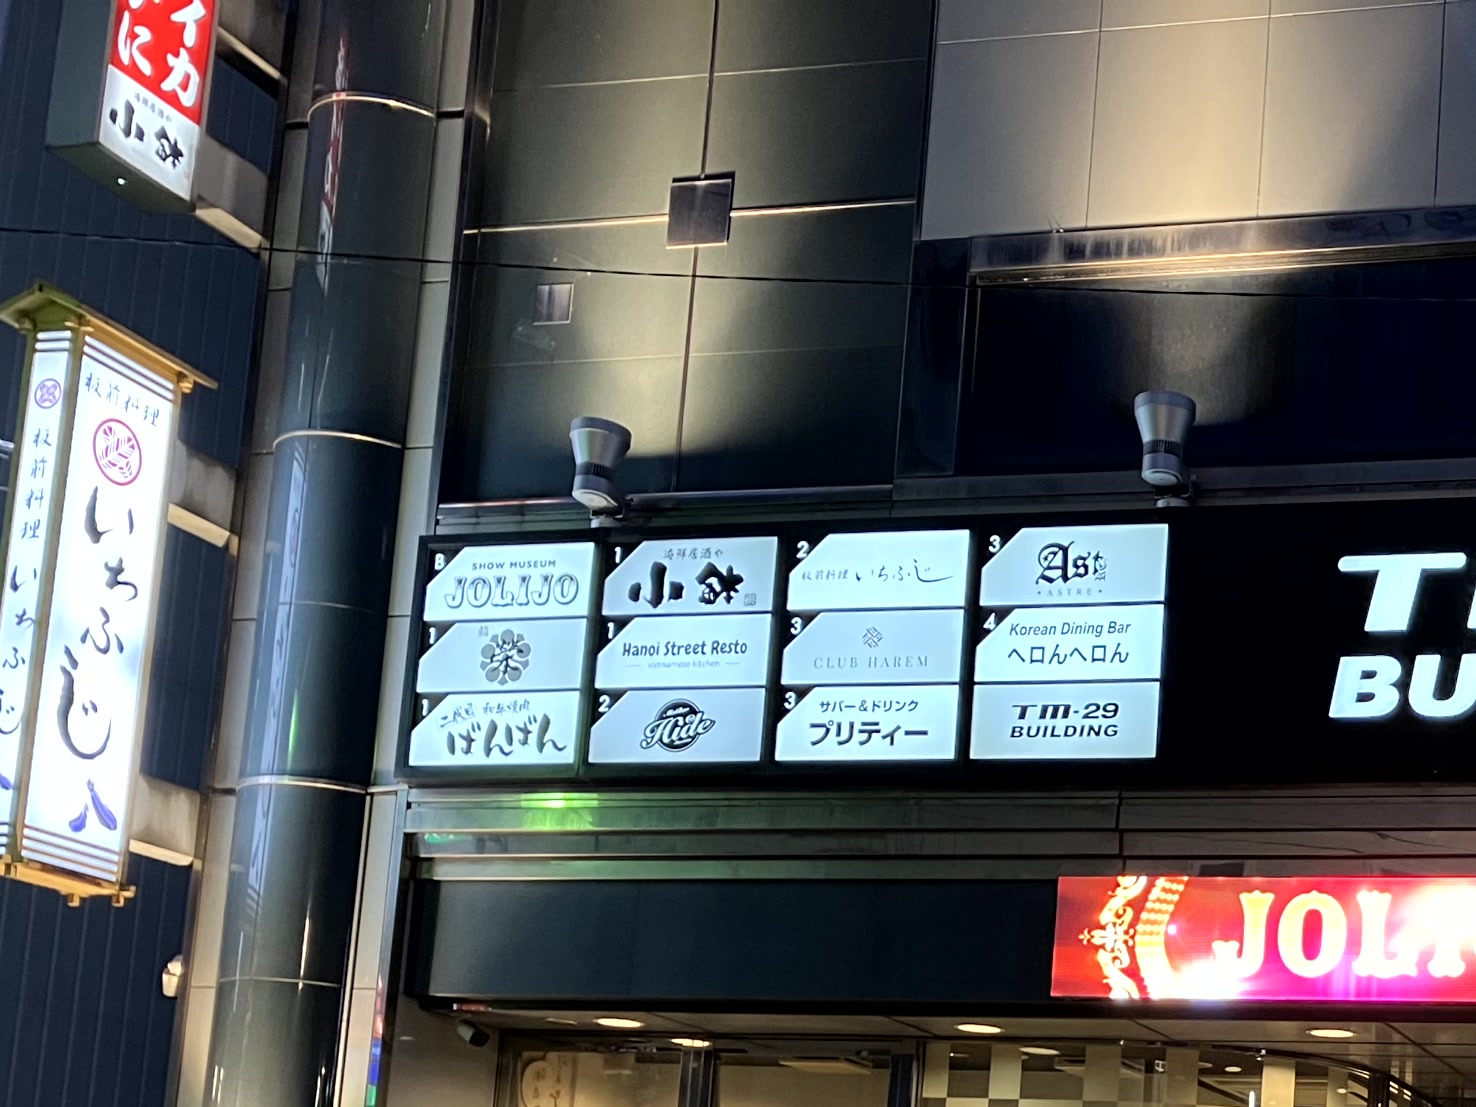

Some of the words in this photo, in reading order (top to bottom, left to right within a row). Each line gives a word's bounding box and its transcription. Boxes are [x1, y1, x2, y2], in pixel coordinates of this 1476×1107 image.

[85, 372, 160, 428] 板前料理
[796, 541, 809, 558] 2
[988, 535, 1001, 553] 3
[434, 553, 445, 570] B
[614, 547, 622, 563] 1
[471, 561, 505, 571] SHOW
[509, 559, 557, 570] MUSEUM
[444, 573, 579, 609] JOLIJO
[607, 623, 615, 639] 1
[790, 617, 802, 635] 3
[983, 613, 997, 631] 4
[1009, 622, 1056, 636] Korean
[1060, 621, 1104, 638] Dining
[1108, 620, 1132, 635] Bar
[429, 627, 436, 645] 1
[622, 642, 660, 657] Hanoi
[664, 640, 706, 656] Street
[711, 639, 748, 655] Resto
[648, 660, 690, 669] vietnamese
[692, 659, 720, 668] kitchen
[814, 657, 858, 669] CLUB
[868, 655, 928, 669] HAREM
[421, 699, 430, 716] 1
[599, 696, 609, 712] 2
[784, 692, 796, 709] 3
[1012, 702, 1119, 721] TM-29
[447, 713, 567, 758] ばんばん
[640, 711, 716, 749] Hide
[809, 720, 929, 747] プリティー
[1010, 725, 1119, 739] BUILDING
